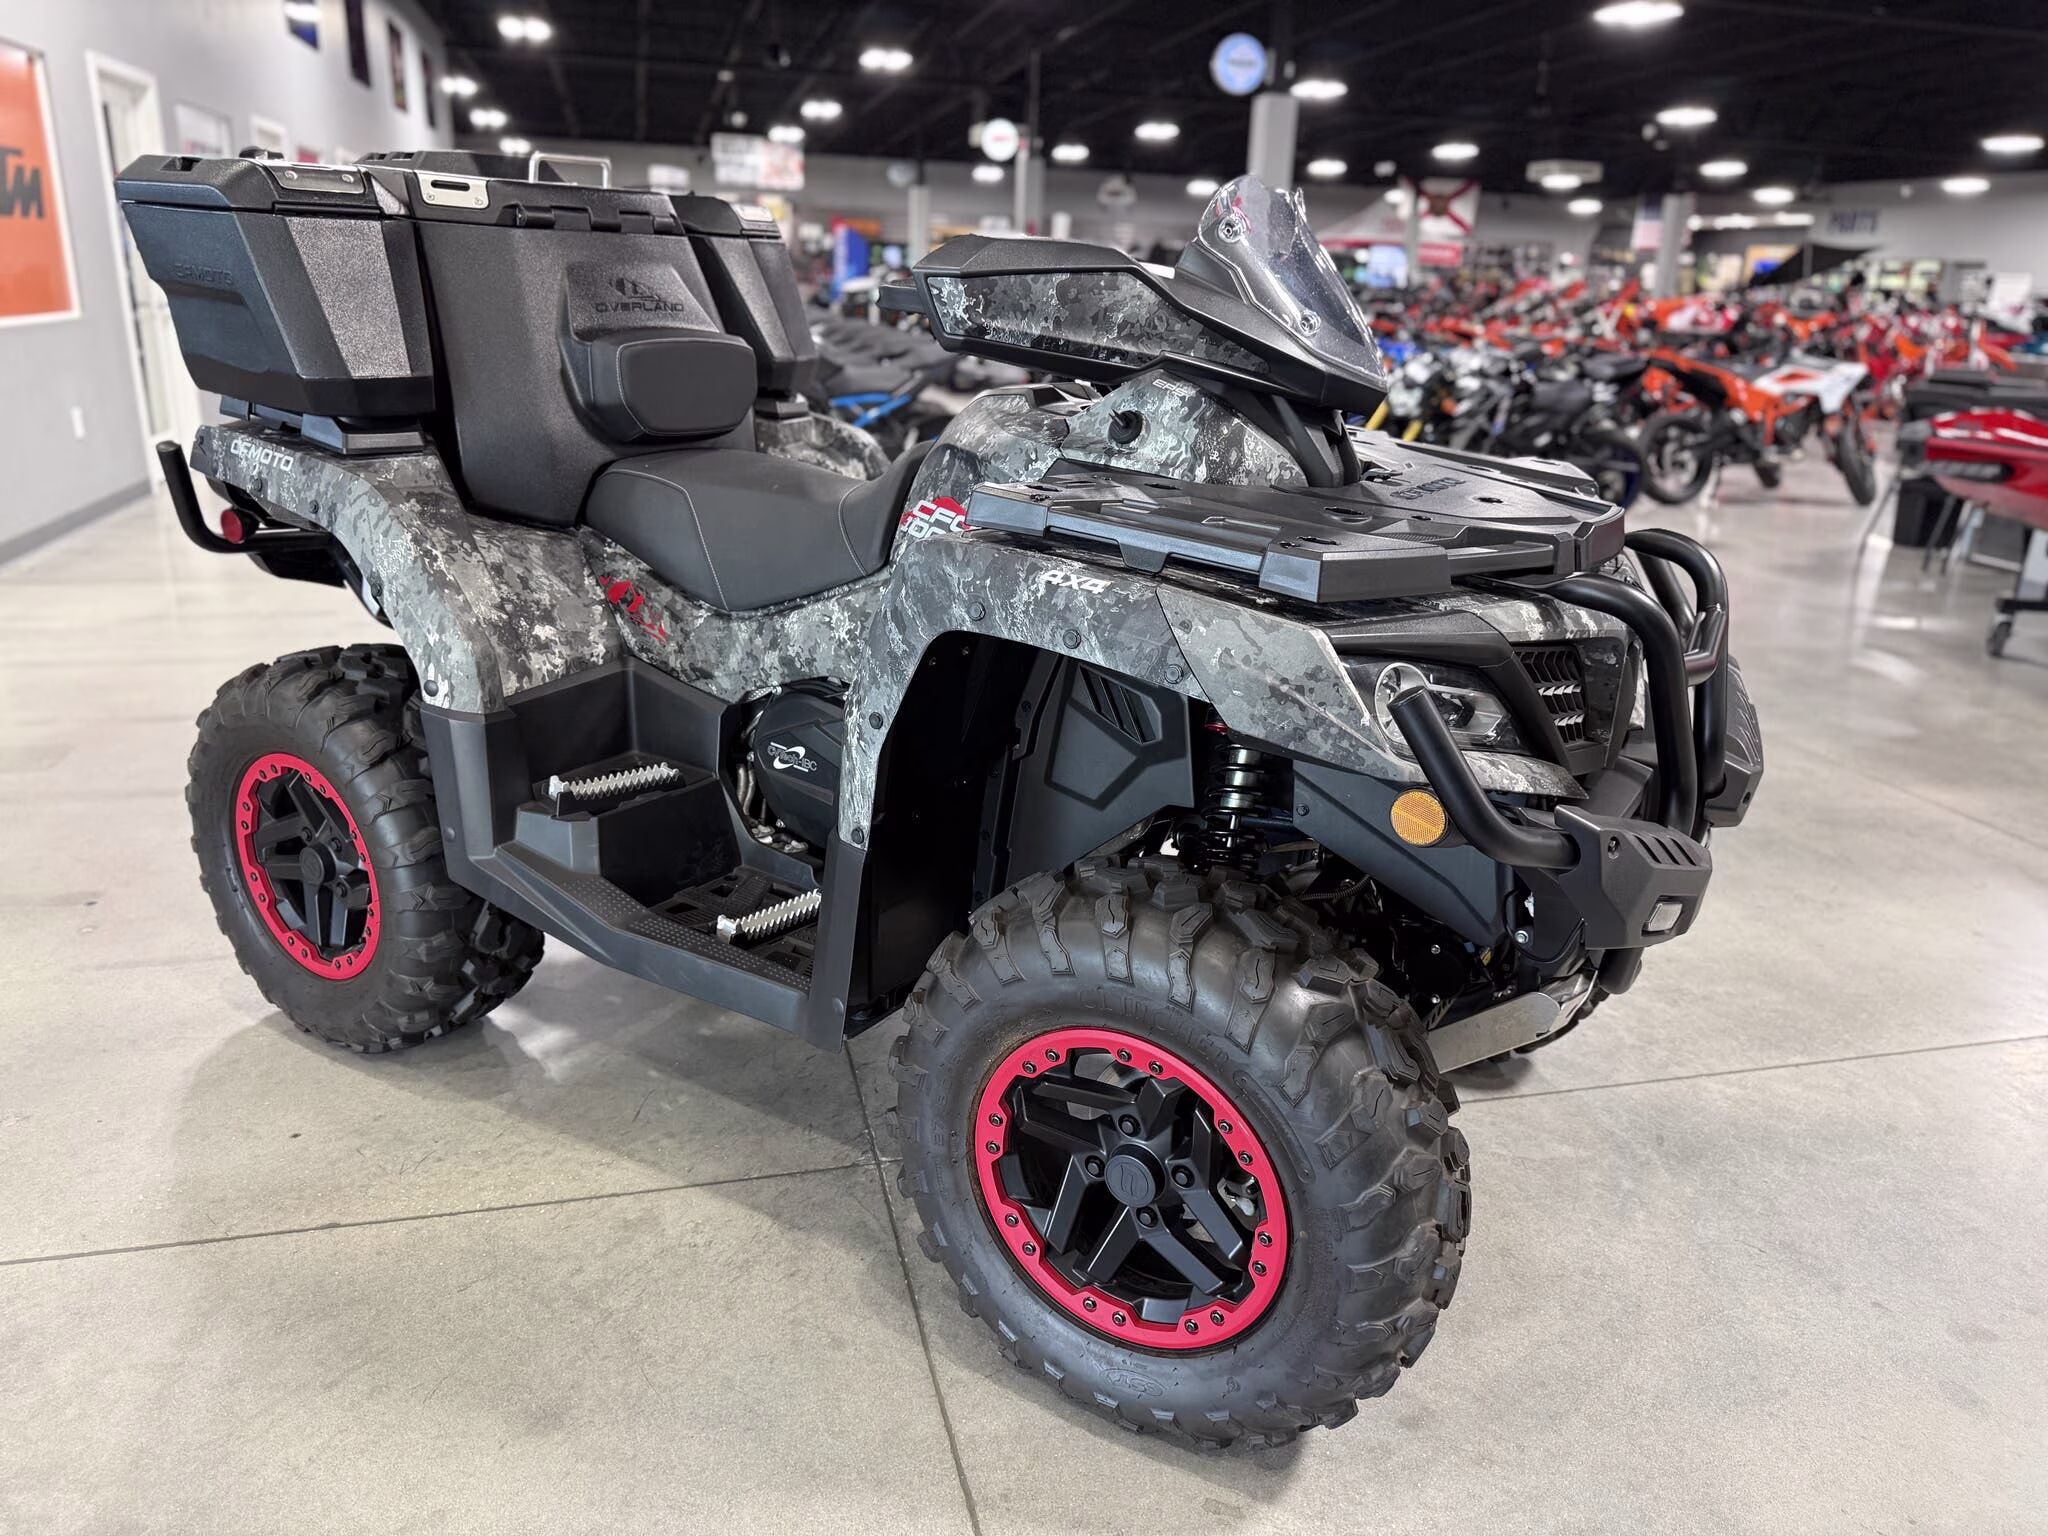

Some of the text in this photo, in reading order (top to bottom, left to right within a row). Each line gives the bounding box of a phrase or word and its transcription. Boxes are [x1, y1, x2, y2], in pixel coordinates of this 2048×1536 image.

[0, 145, 44, 219] TM
[595, 302, 684, 313] OVERLAND
[1152, 379, 1188, 398] EPS
[230, 439, 294, 472] CFMOTO
[1040, 569, 1113, 594] 4X4
